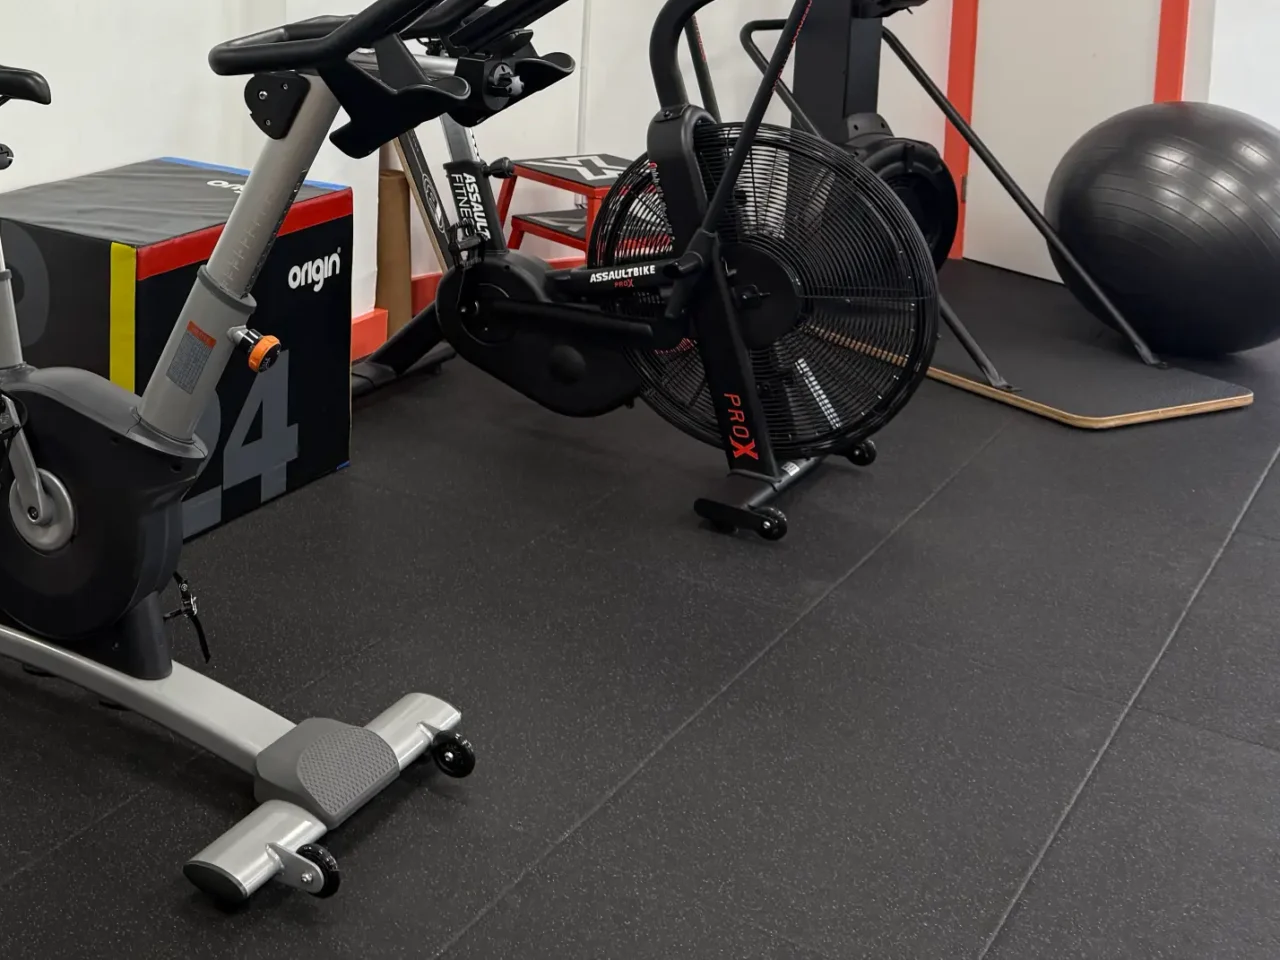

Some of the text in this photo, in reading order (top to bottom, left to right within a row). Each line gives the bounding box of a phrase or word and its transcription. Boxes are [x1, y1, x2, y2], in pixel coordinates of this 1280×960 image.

[206, 179, 244, 194] ori
[451, 173, 477, 227] FITNE
[463, 172, 492, 241] ASSAULT
[287, 251, 342, 293] origin
[589, 264, 657, 283] ASSAULTBIKE
